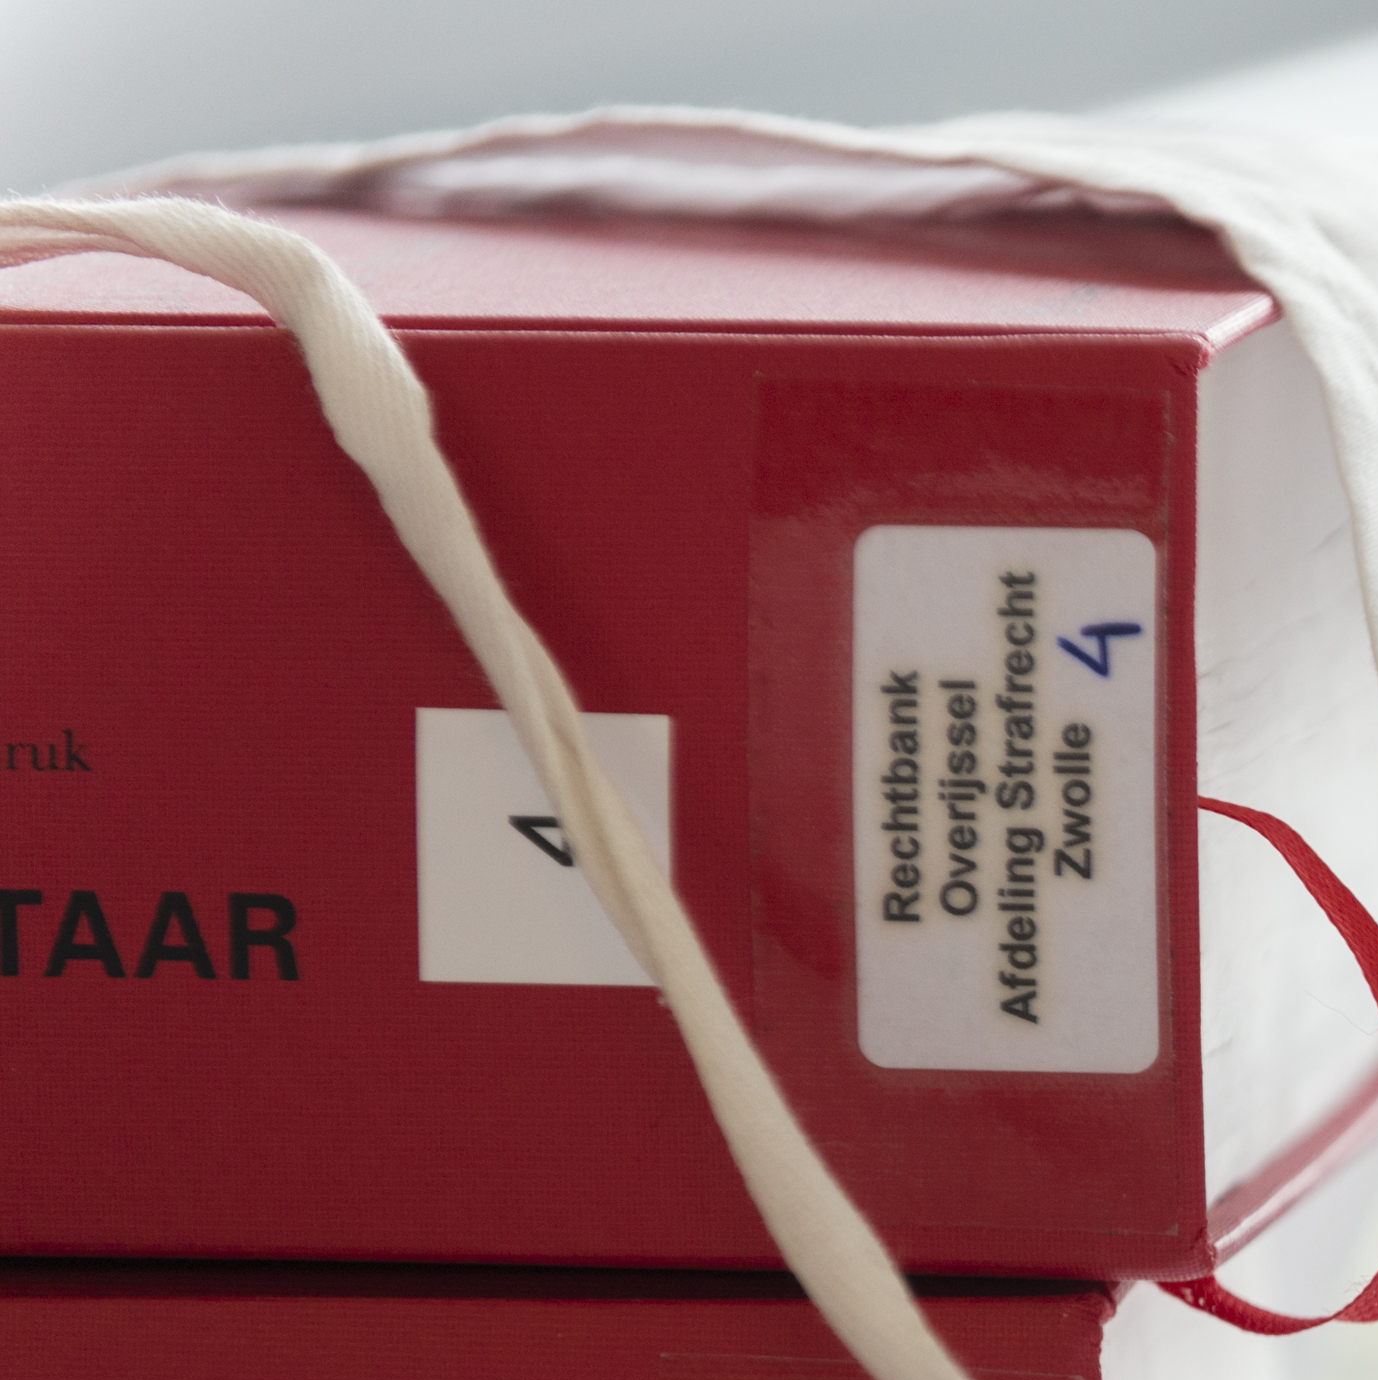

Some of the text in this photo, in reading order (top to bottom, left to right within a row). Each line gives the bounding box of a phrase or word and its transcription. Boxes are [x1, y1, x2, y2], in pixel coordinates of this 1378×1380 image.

[1057, 621, 1144, 678] 4
[5, 729, 92, 773] ruk
[881, 670, 922, 923] Rechtbank
[938, 680, 987, 917] Overijssel
[994, 570, 1046, 1025] Afdeling Strafrecht
[1053, 722, 1093, 880] Zwolle
[0, 888, 300, 982] TAAR
